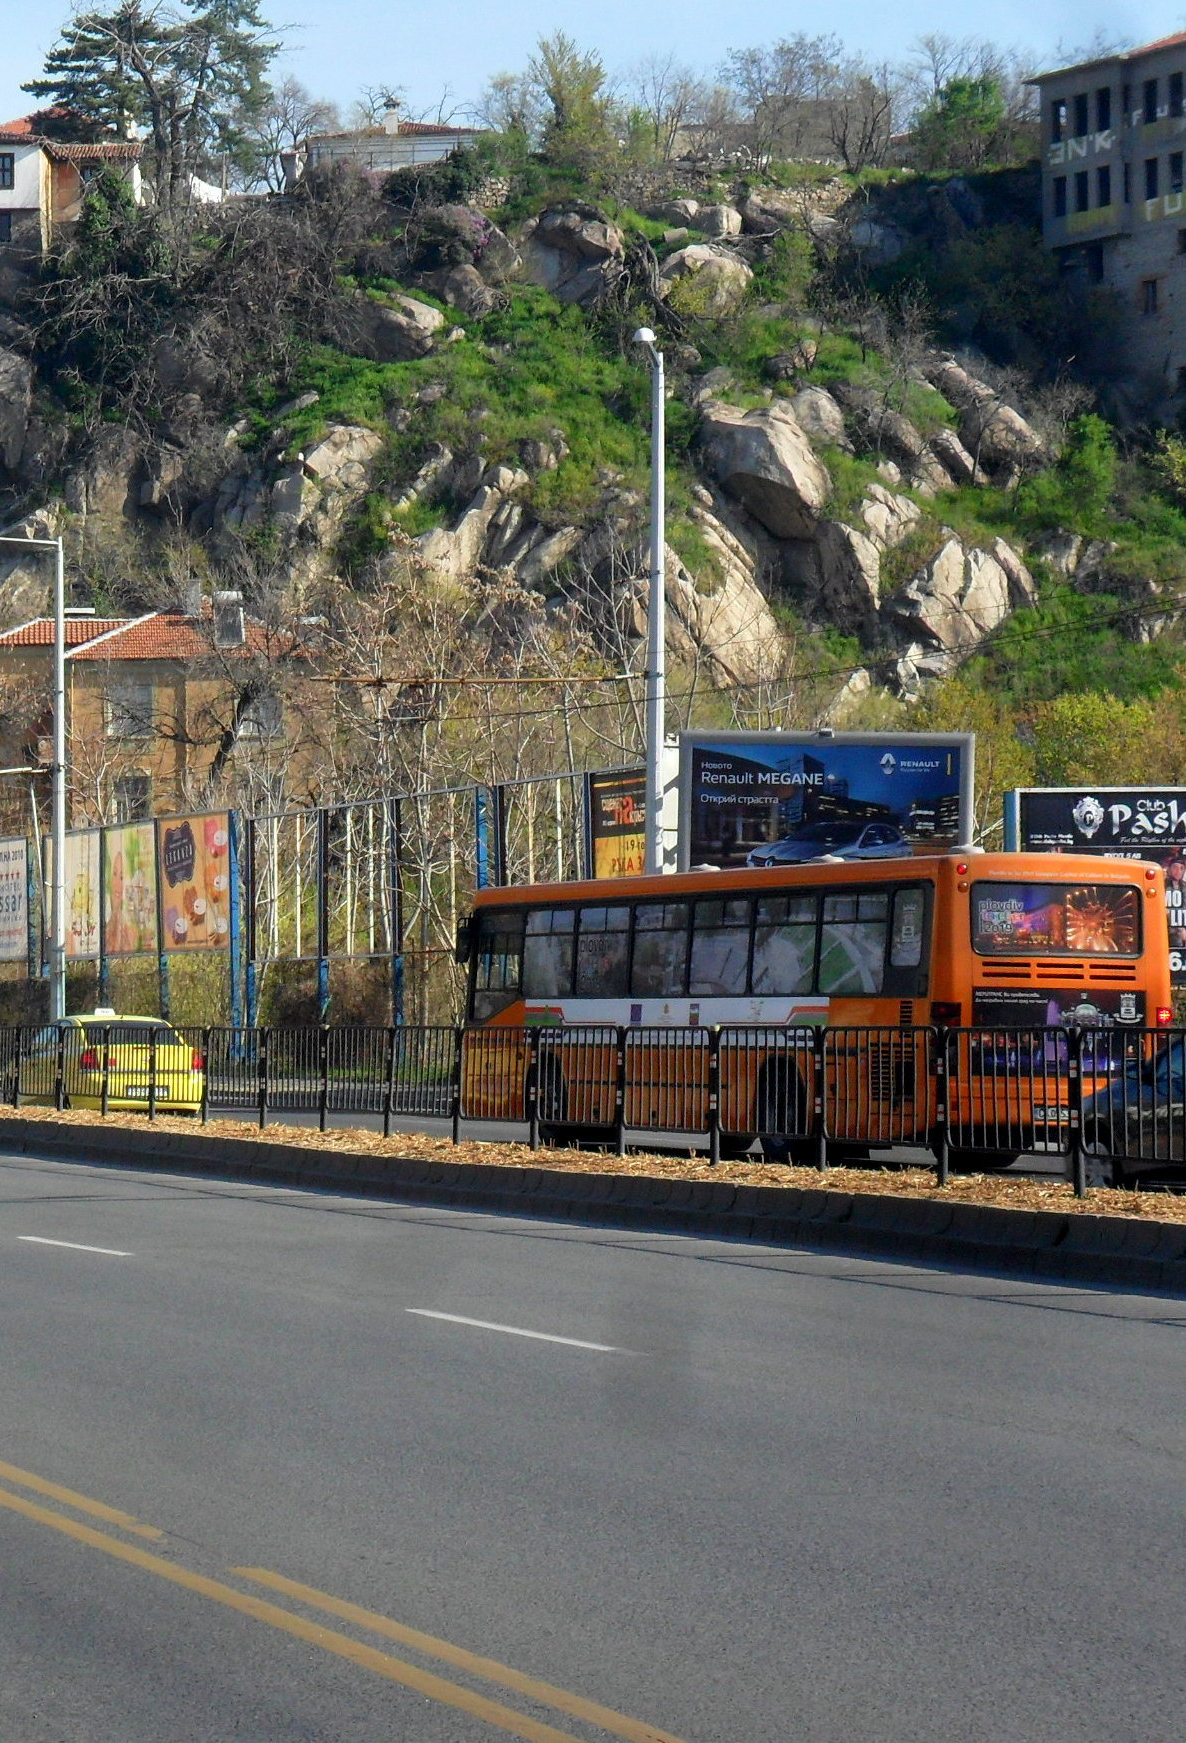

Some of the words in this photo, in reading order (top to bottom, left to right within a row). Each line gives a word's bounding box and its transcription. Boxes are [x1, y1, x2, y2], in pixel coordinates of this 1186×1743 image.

[701, 761, 733, 770] Новото
[701, 772, 754, 784] Renault
[758, 773, 824, 785] MEGANE
[700, 793, 737, 804] Открий
[738, 795, 779, 805] страстта
[1136, 799, 1165, 812] Club
